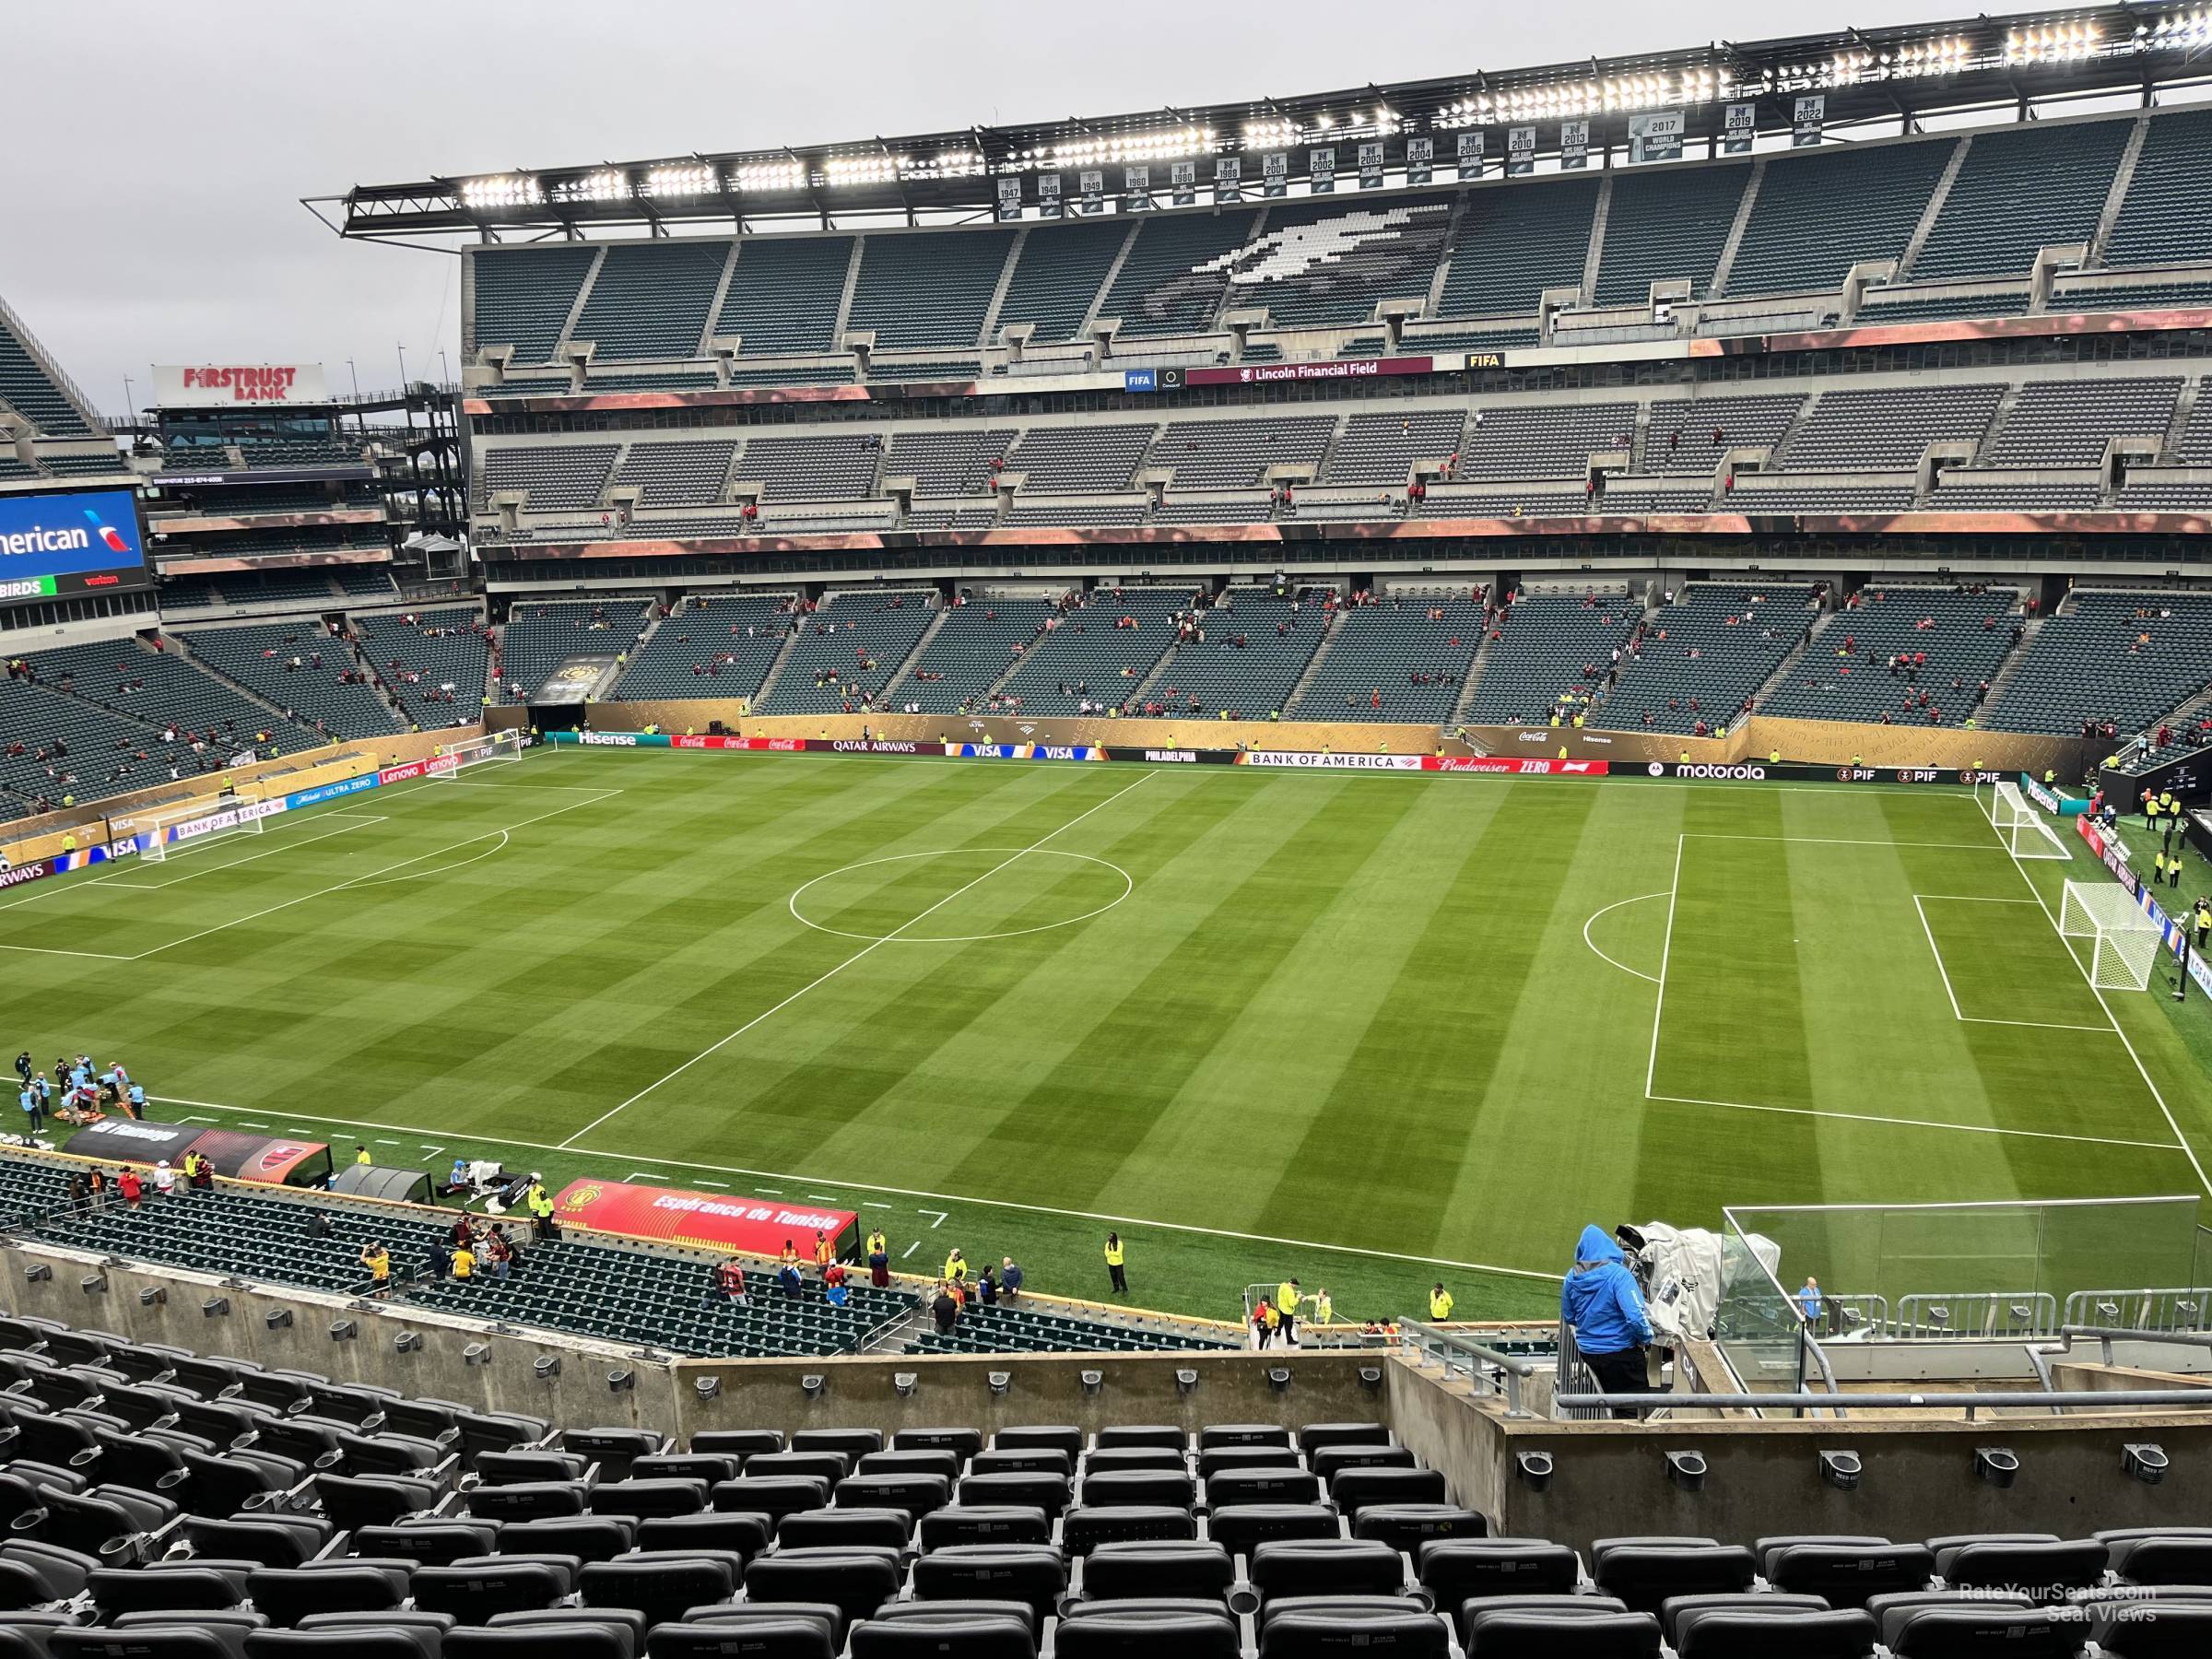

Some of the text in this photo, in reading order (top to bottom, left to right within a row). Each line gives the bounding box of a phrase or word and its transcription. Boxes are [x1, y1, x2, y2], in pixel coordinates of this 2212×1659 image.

[1797, 109, 1821, 120] 2022
[1653, 121, 1675, 132] 2017
[1729, 117, 1750, 127] 2019
[1512, 139, 1531, 149] 2010
[1565, 134, 1584, 144] 2013
[1461, 144, 1481, 155] 2006
[1646, 142, 1681, 151] CHAMPIONS
[1361, 155, 1381, 164] 2003
[1410, 150, 1430, 160] 2004
[1266, 165, 1284, 174] 2001
[1313, 160, 1332, 170] 2002
[1175, 173, 1192, 182] 1980
[1220, 169, 1237, 178] 1988
[1083, 182, 1100, 191] 1949
[1129, 178, 1146, 187] 1960
[1001, 189, 1018, 197] 1947
[1041, 186, 1058, 194] 1948
[1470, 355, 1499, 367] FIFA
[1256, 362, 1377, 380] Lincoln Financial Field
[1129, 376, 1150, 385] FIFA
[235, 386, 287, 400] BANK
[85, 575, 118, 586] verizon
[520, 737, 532, 747] PIF
[578, 732, 636, 745] Hisense
[1583, 735, 1612, 744] Hisense
[481, 747, 493, 757] PIF
[833, 741, 916, 753] QATAR AIRWAYS
[972, 745, 1001, 757] VISA
[1042, 747, 1074, 759] VISA
[1145, 751, 1196, 762] PHILADELPHIA
[424, 757, 458, 772] Lenovo
[1253, 754, 1394, 767] BANK OF AMERICA
[1437, 759, 1550, 773] Budweiser ZERO
[382, 767, 418, 783] Lenovo
[1677, 763, 1765, 779] motorola
[1853, 770, 1875, 780] PIF
[1914, 771, 1937, 782] PIF
[1977, 772, 2000, 783] PIF
[326, 785, 349, 796] ULTRA
[351, 779, 370, 790] ZERO
[2027, 778, 2058, 815] Hisense
[110, 819, 134, 831] VISA
[180, 821, 208, 836] BANK
[211, 818, 223, 828] OF
[100, 838, 138, 859] VISA
[653, 1196, 840, 1230] Espérance de Tunisie
